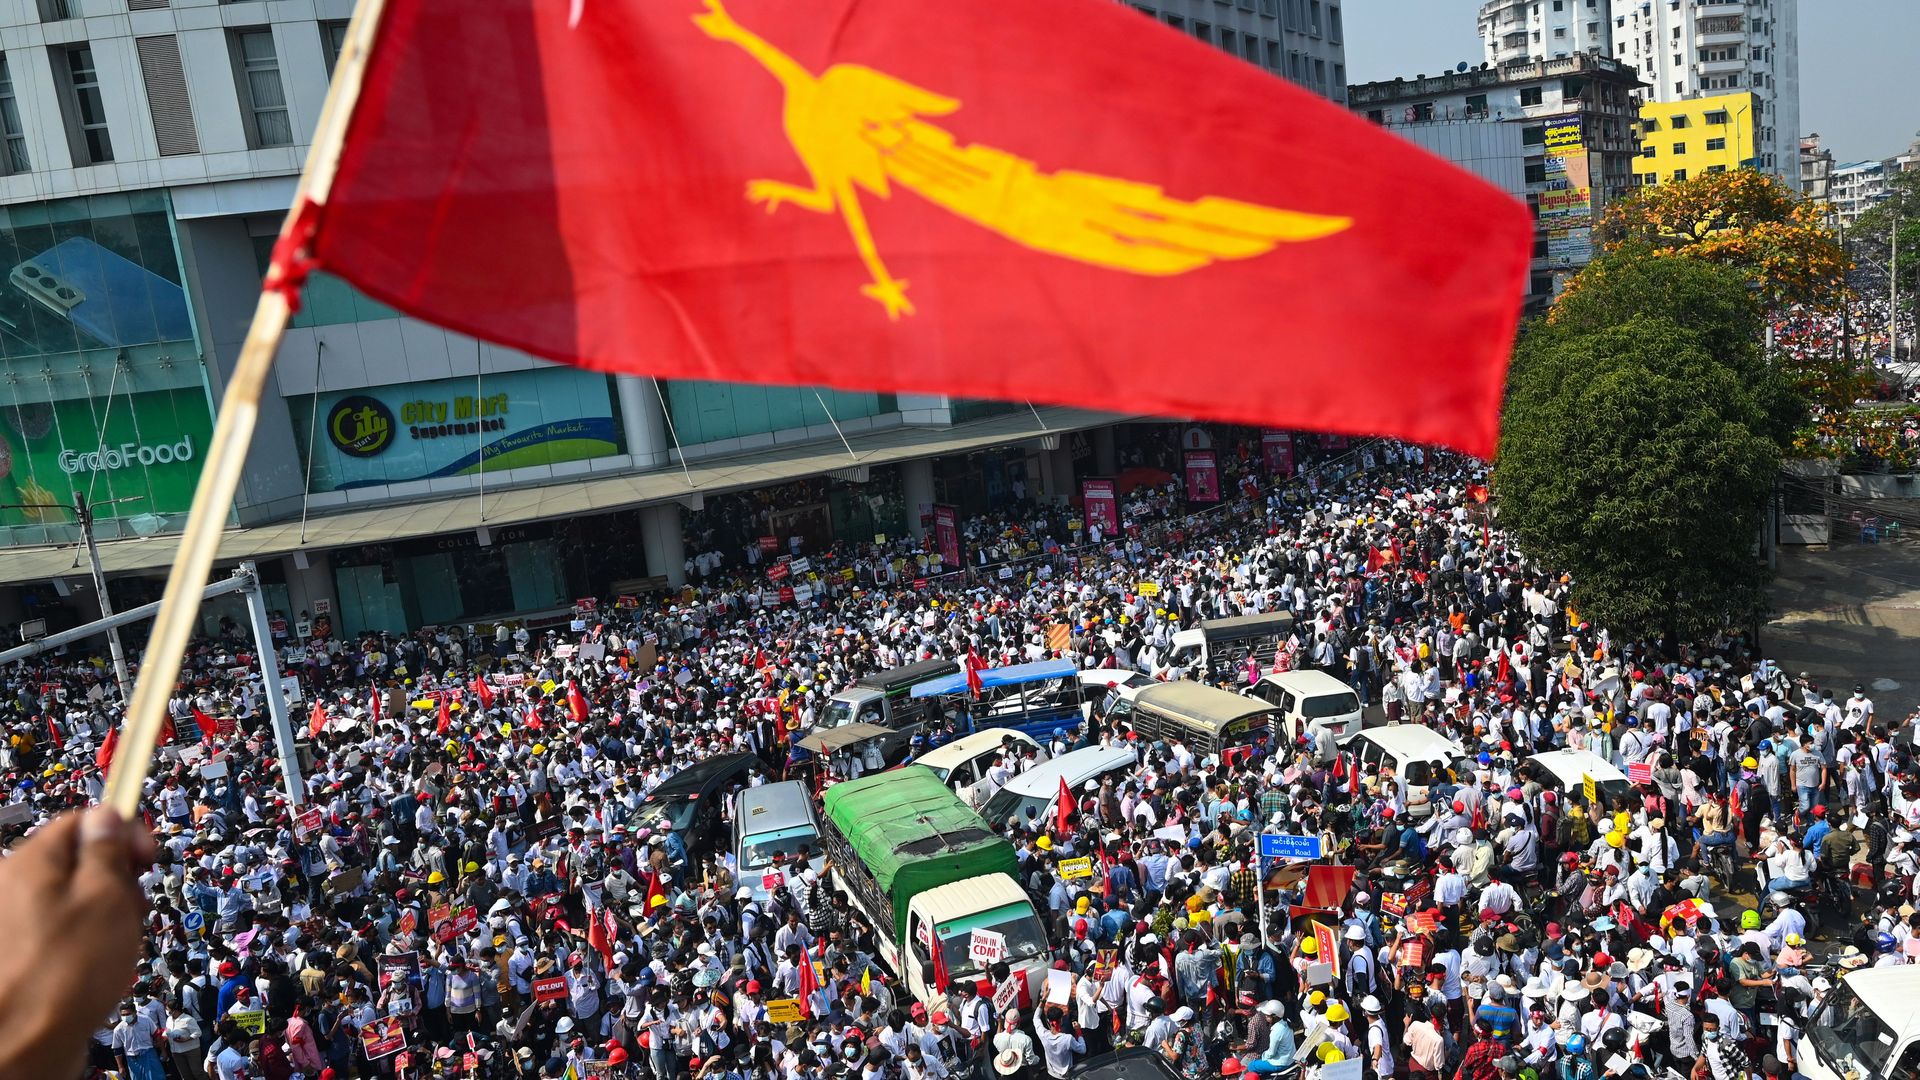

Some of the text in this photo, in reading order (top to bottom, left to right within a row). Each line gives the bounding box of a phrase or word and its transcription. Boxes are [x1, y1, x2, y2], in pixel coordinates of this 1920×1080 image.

[401, 393, 509, 425] City Mart
[410, 417, 506, 440] Supermarket
[58, 434, 192, 474] GrabFood
[1271, 837, 1310, 848] အင်းစိန်လမ်း
[1271, 847, 1311, 856] Insein Road
[989, 938, 997, 947] IN
[550, 981, 564, 989] OUT
